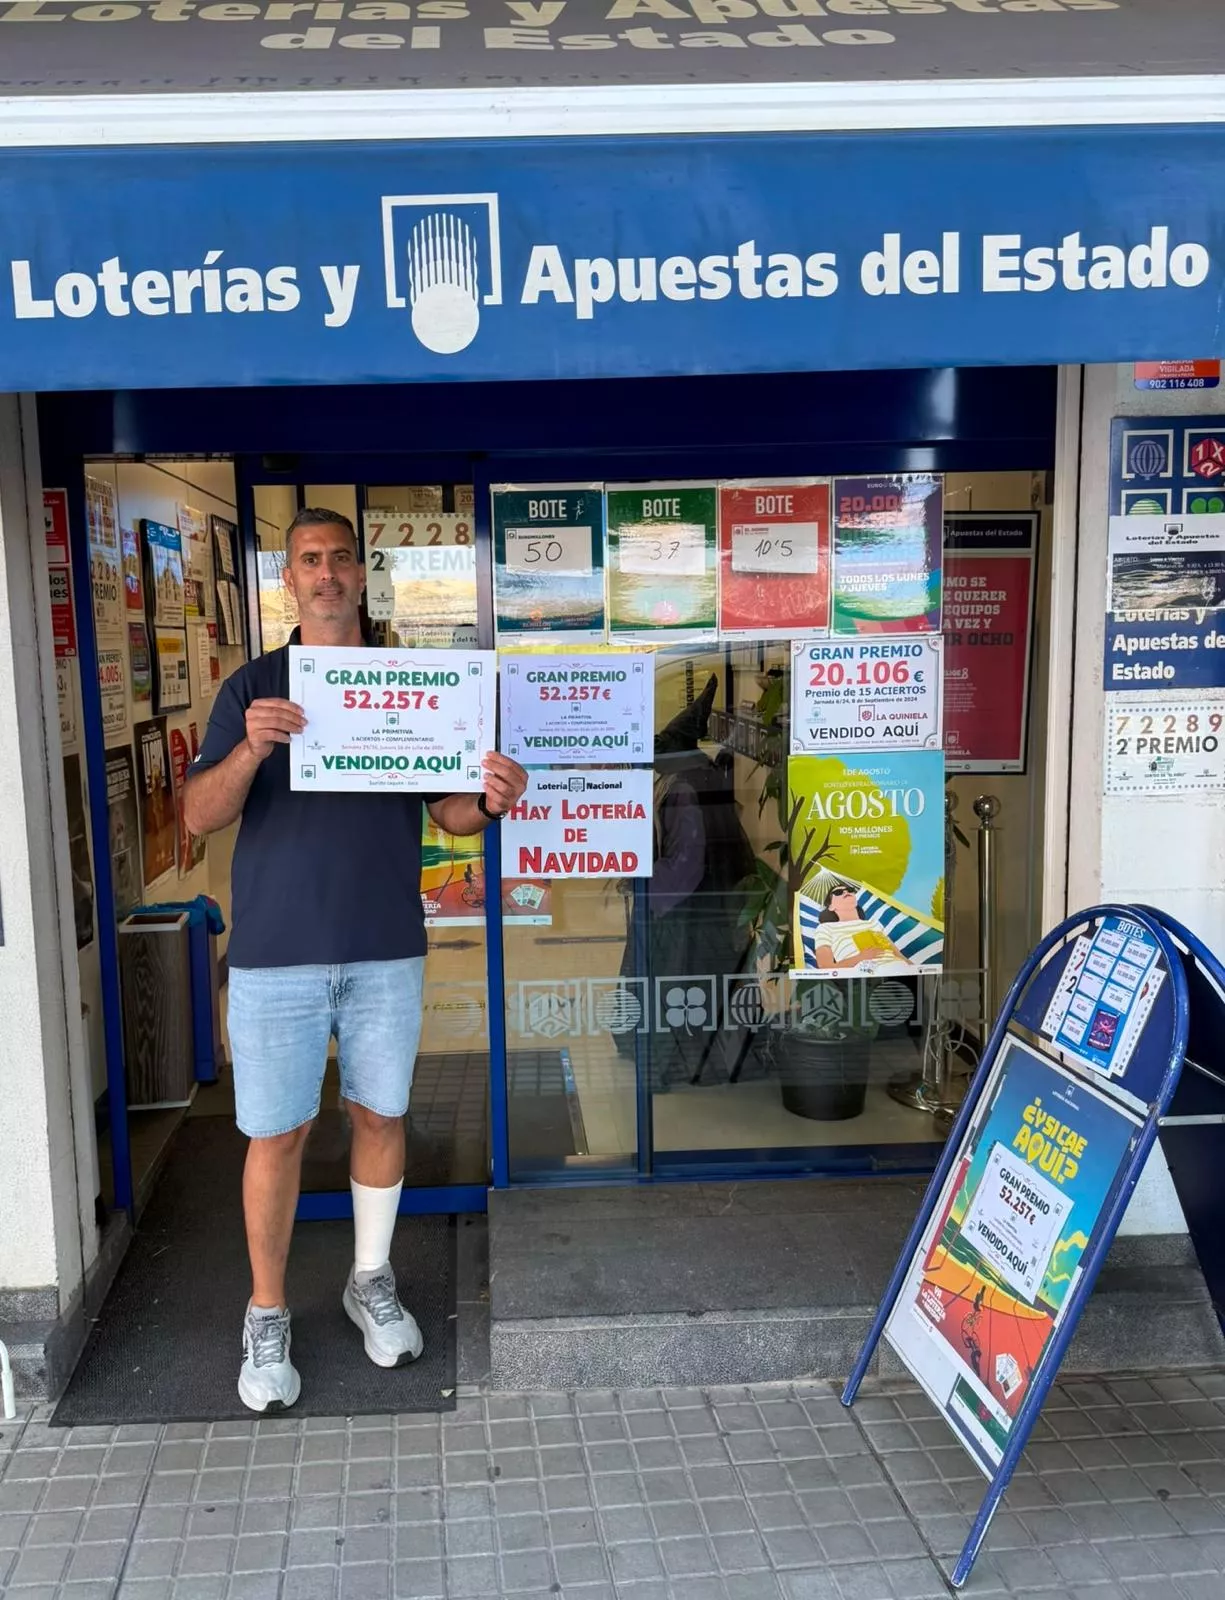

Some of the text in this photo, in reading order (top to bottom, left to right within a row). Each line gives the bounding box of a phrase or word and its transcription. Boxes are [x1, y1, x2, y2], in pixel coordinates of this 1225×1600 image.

[503, 0, 565, 26] y
[260, 24, 896, 50] del Estado
[11, 225, 1209, 327] Loterías y Apuestas del Estado
[1160, 365, 1195, 373] VIGILADA
[1149, 380, 1167, 388] 902
[1187, 379, 1205, 387] 408
[529, 499, 567, 518] BOTE
[643, 498, 681, 517] BOTE
[755, 495, 794, 515] BOTE
[950, 529, 1023, 538] Apuestas del Estado
[524, 541, 562, 563] 50
[649, 540, 680, 560] 37
[840, 572, 930, 584] TODOS LOS LUNES
[970, 576, 987, 587] SE
[840, 583, 888, 592] Y JUEVES
[954, 590, 1007, 602] QUERER
[944, 604, 1001, 615] EQUIPOS
[955, 618, 980, 629] VEZ
[983, 618, 992, 629] Y
[967, 632, 1014, 646] OCHO
[1113, 633, 1198, 655] Apuestas
[810, 644, 923, 660] GRAN PREMIO
[325, 670, 460, 686] GRAN PREMIO
[526, 670, 627, 683] GRAN PREMIO
[809, 661, 909, 686] 20.106
[914, 671, 924, 683] €
[1112, 661, 1176, 681] Estado
[343, 690, 439, 710] 52.257 €
[539, 686, 612, 701] 52.257 €
[805, 686, 926, 698] Premio de 15 ACIERTOS
[810, 722, 919, 739] VENDIDO AQUÍ
[524, 731, 628, 748] VENDIDO AQUÍ
[1136, 736, 1218, 754] PREMIO
[322, 751, 462, 773] VENDIDO AQUÍ
[858, 767, 891, 775] AGOSTO
[586, 781, 622, 790] Nacional
[807, 788, 925, 820] AGOSTO
[564, 828, 588, 842] DE
[840, 825, 893, 834] 105 MILLONES
[1117, 920, 1146, 939] BOTES
[999, 1167, 1050, 1216] GRAN PREMIO
[999, 1185, 1032, 1217] 52.257
[977, 1220, 1008, 1256] VENDIDO
[1006, 1252, 1029, 1277] AQUÍ
